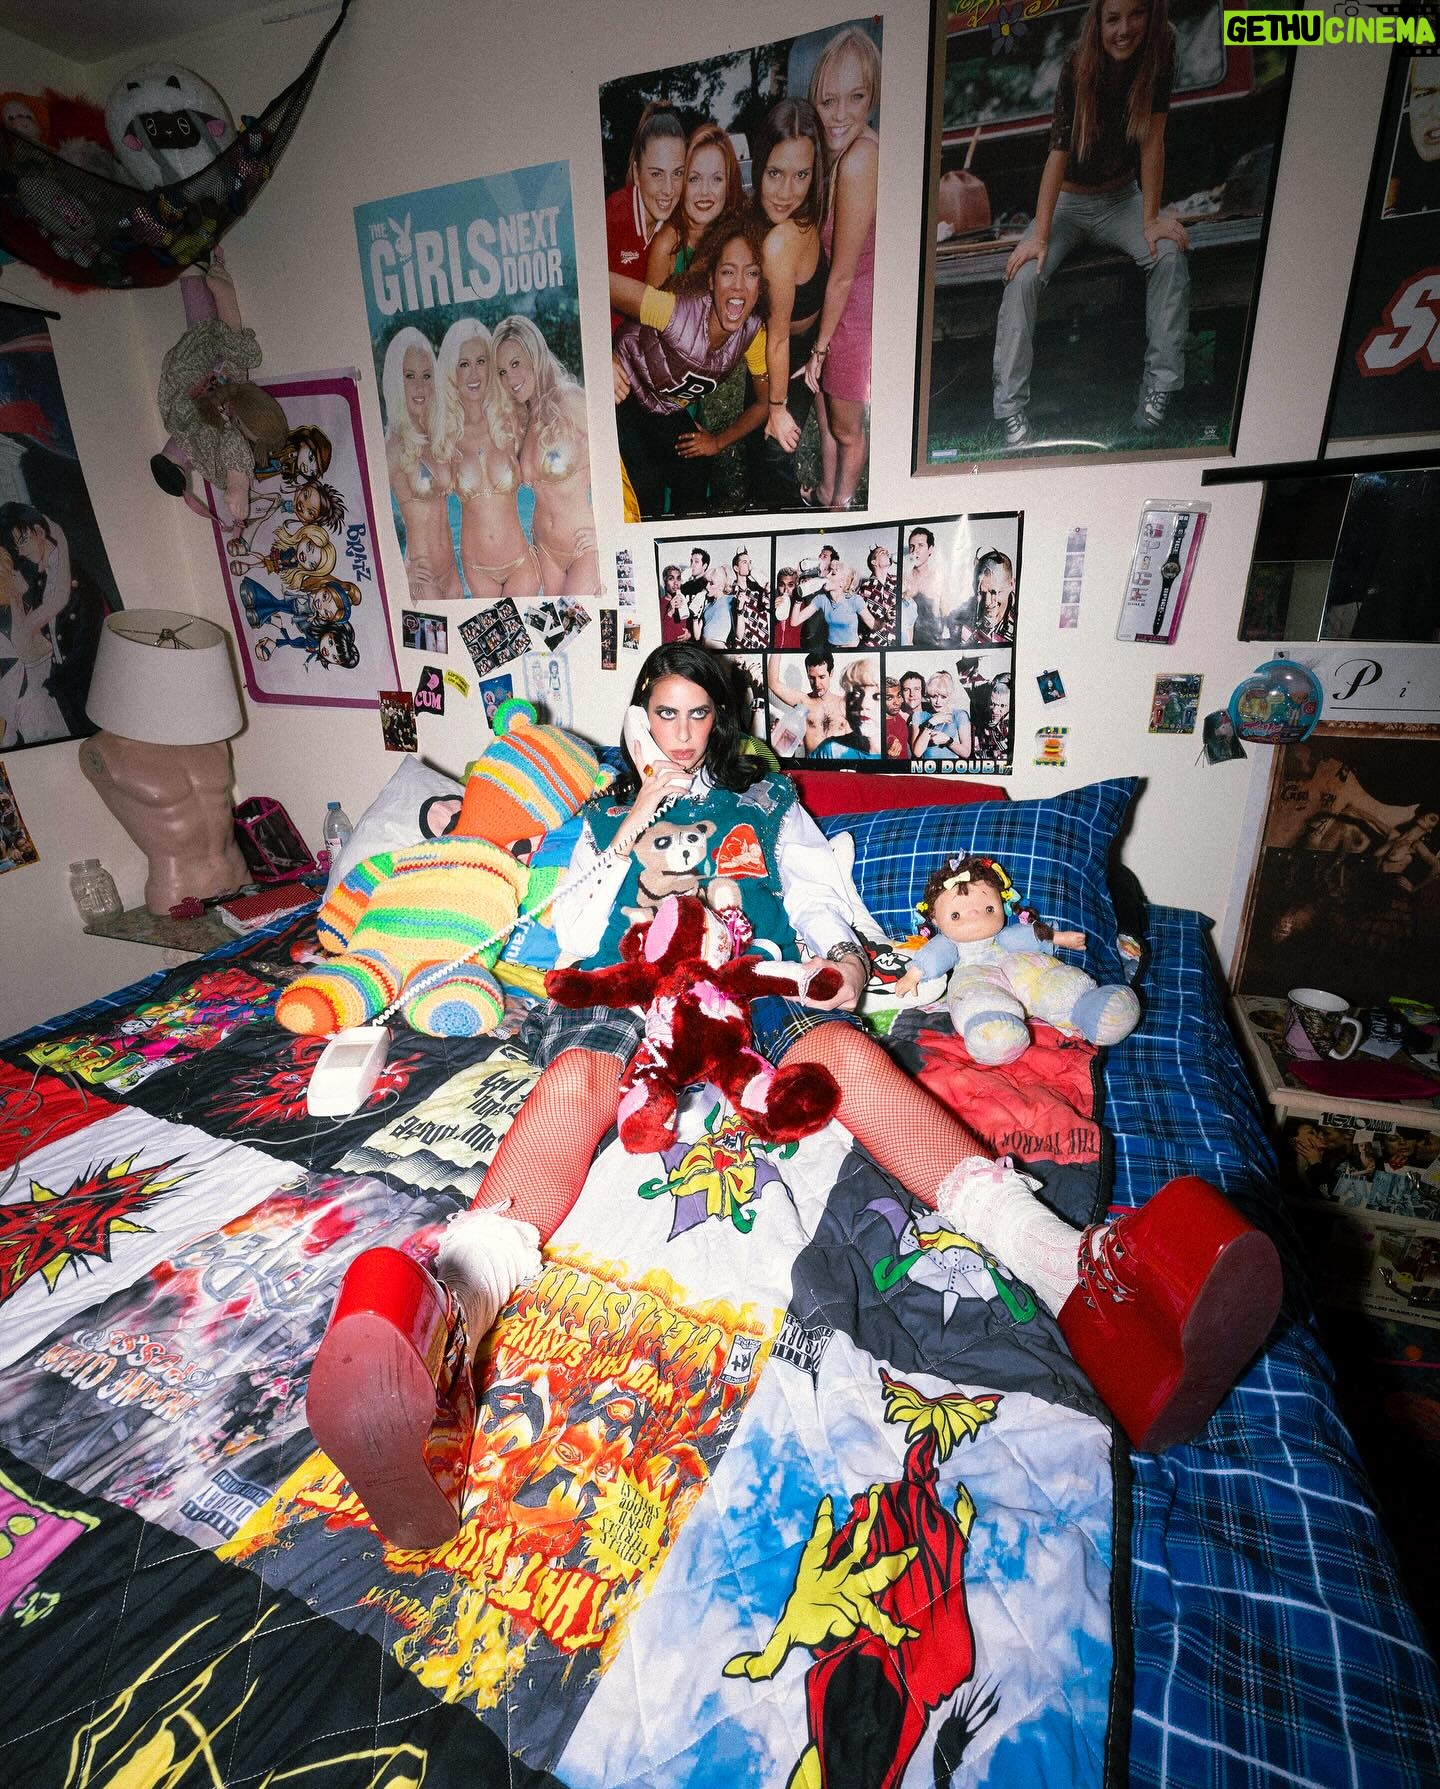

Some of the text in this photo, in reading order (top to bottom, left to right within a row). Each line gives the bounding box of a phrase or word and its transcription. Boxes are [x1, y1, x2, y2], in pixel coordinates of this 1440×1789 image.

[368, 223, 388, 242] THE
[498, 207, 561, 256] NEXT
[503, 249, 564, 297] DOOR
[347, 523, 372, 583] BRATZ
[414, 690, 442, 711] CUM
[910, 760, 1009, 775] NO DOUBT
[193, 1484, 251, 1525] DVISORY
[599, 1517, 650, 1557] THRILLS
[599, 1531, 642, 1567] CHILLS
[487, 1551, 609, 1651] THAT
